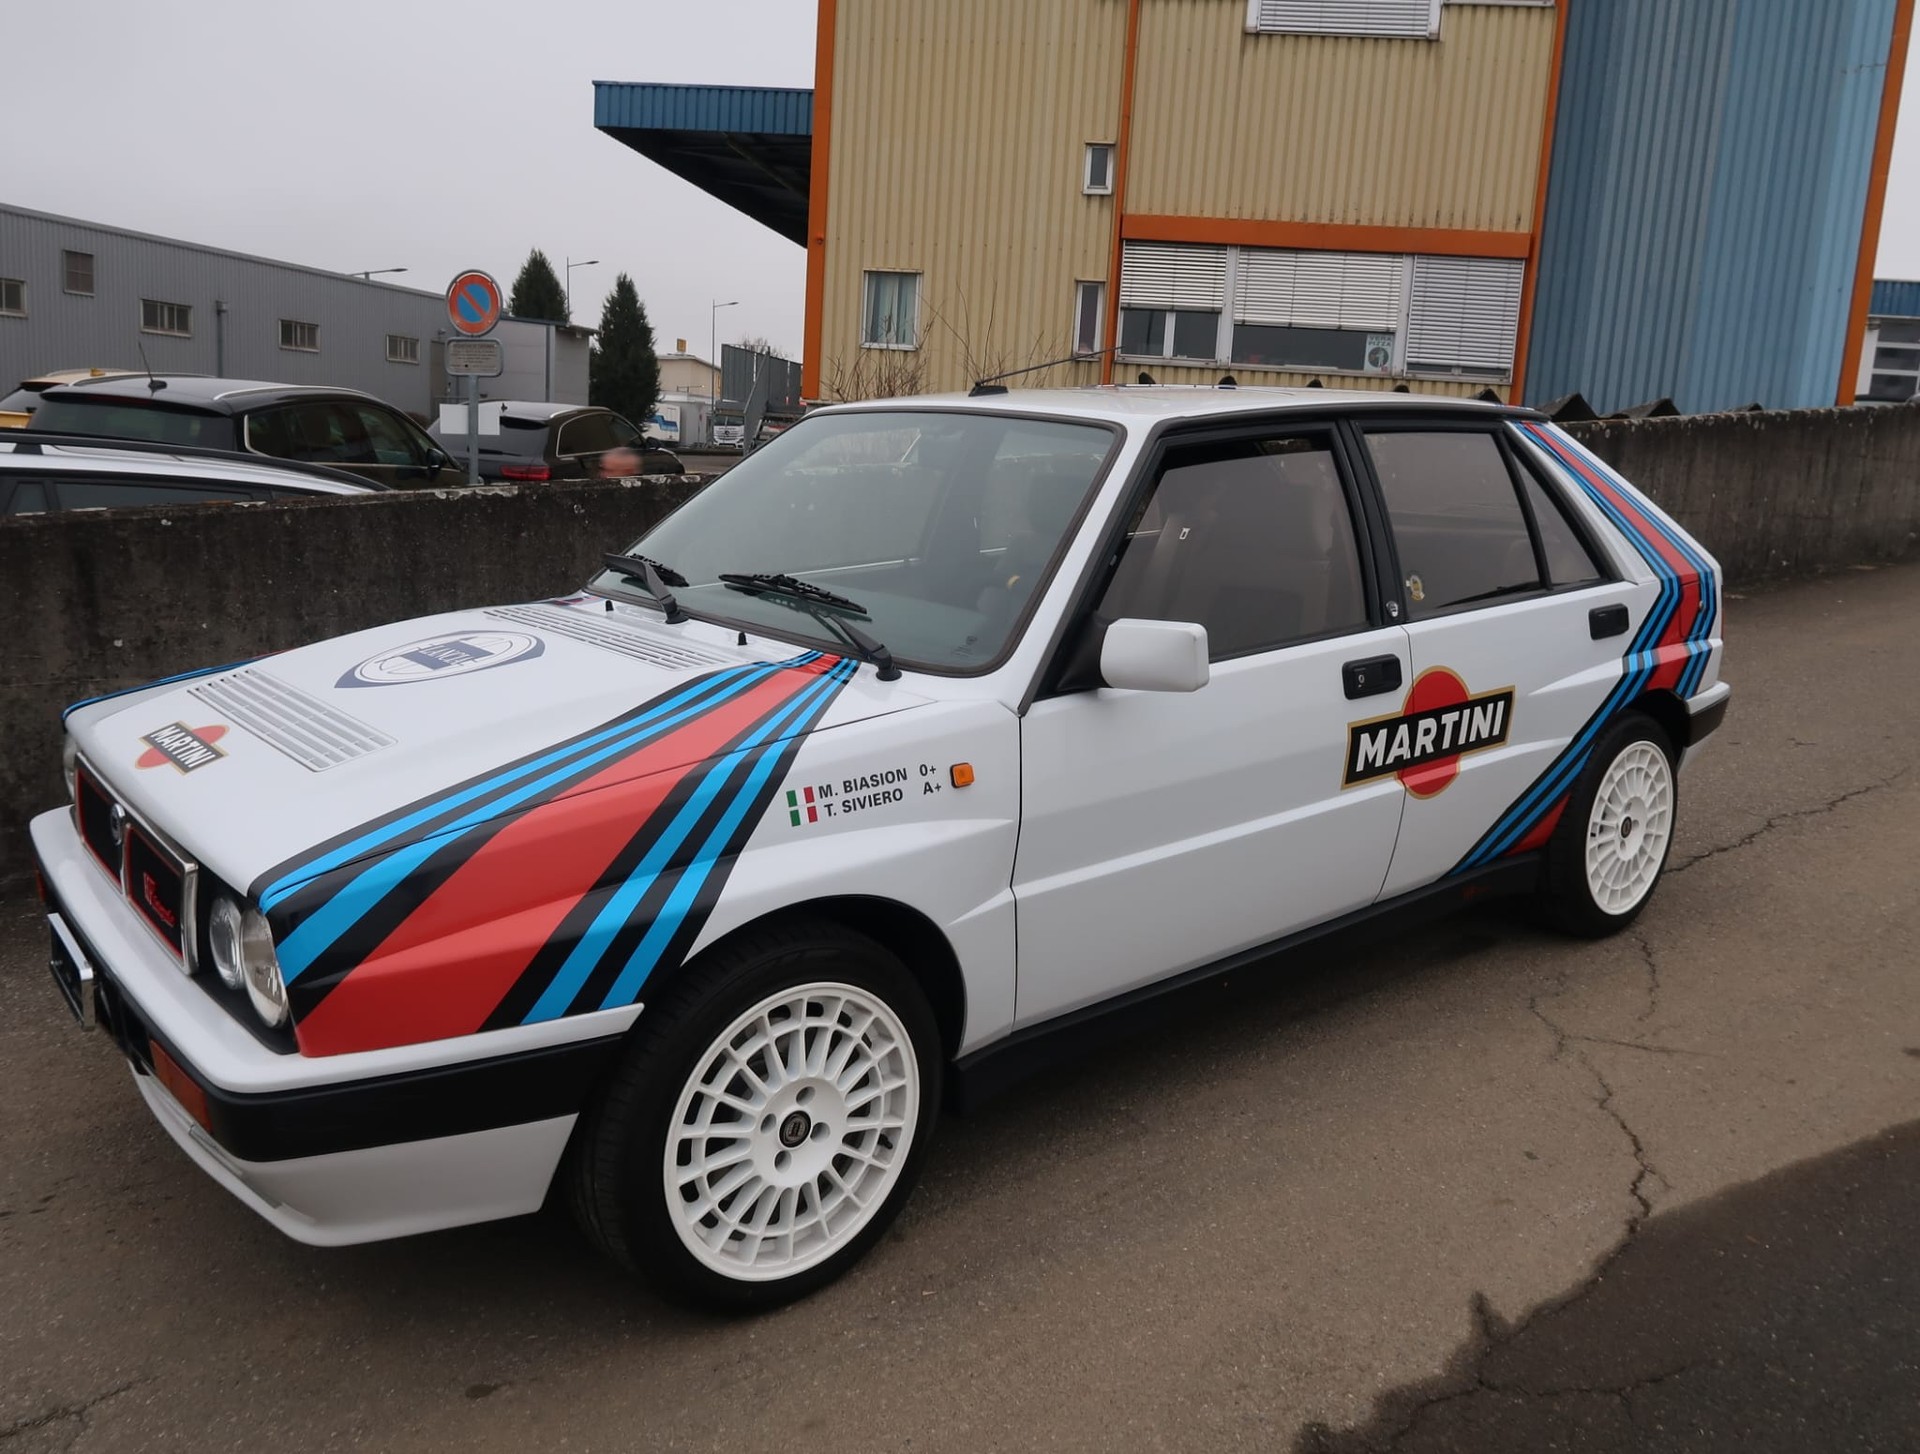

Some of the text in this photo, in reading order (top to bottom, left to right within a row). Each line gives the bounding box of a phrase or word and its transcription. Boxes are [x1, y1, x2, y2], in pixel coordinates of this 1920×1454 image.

[149, 725, 216, 768] MARTINI
[1356, 700, 1505, 773] MARTINI
[819, 784, 838, 800] M.
[843, 768, 908, 794] BIASION
[824, 781, 942, 818] T. SIVIERO A+
